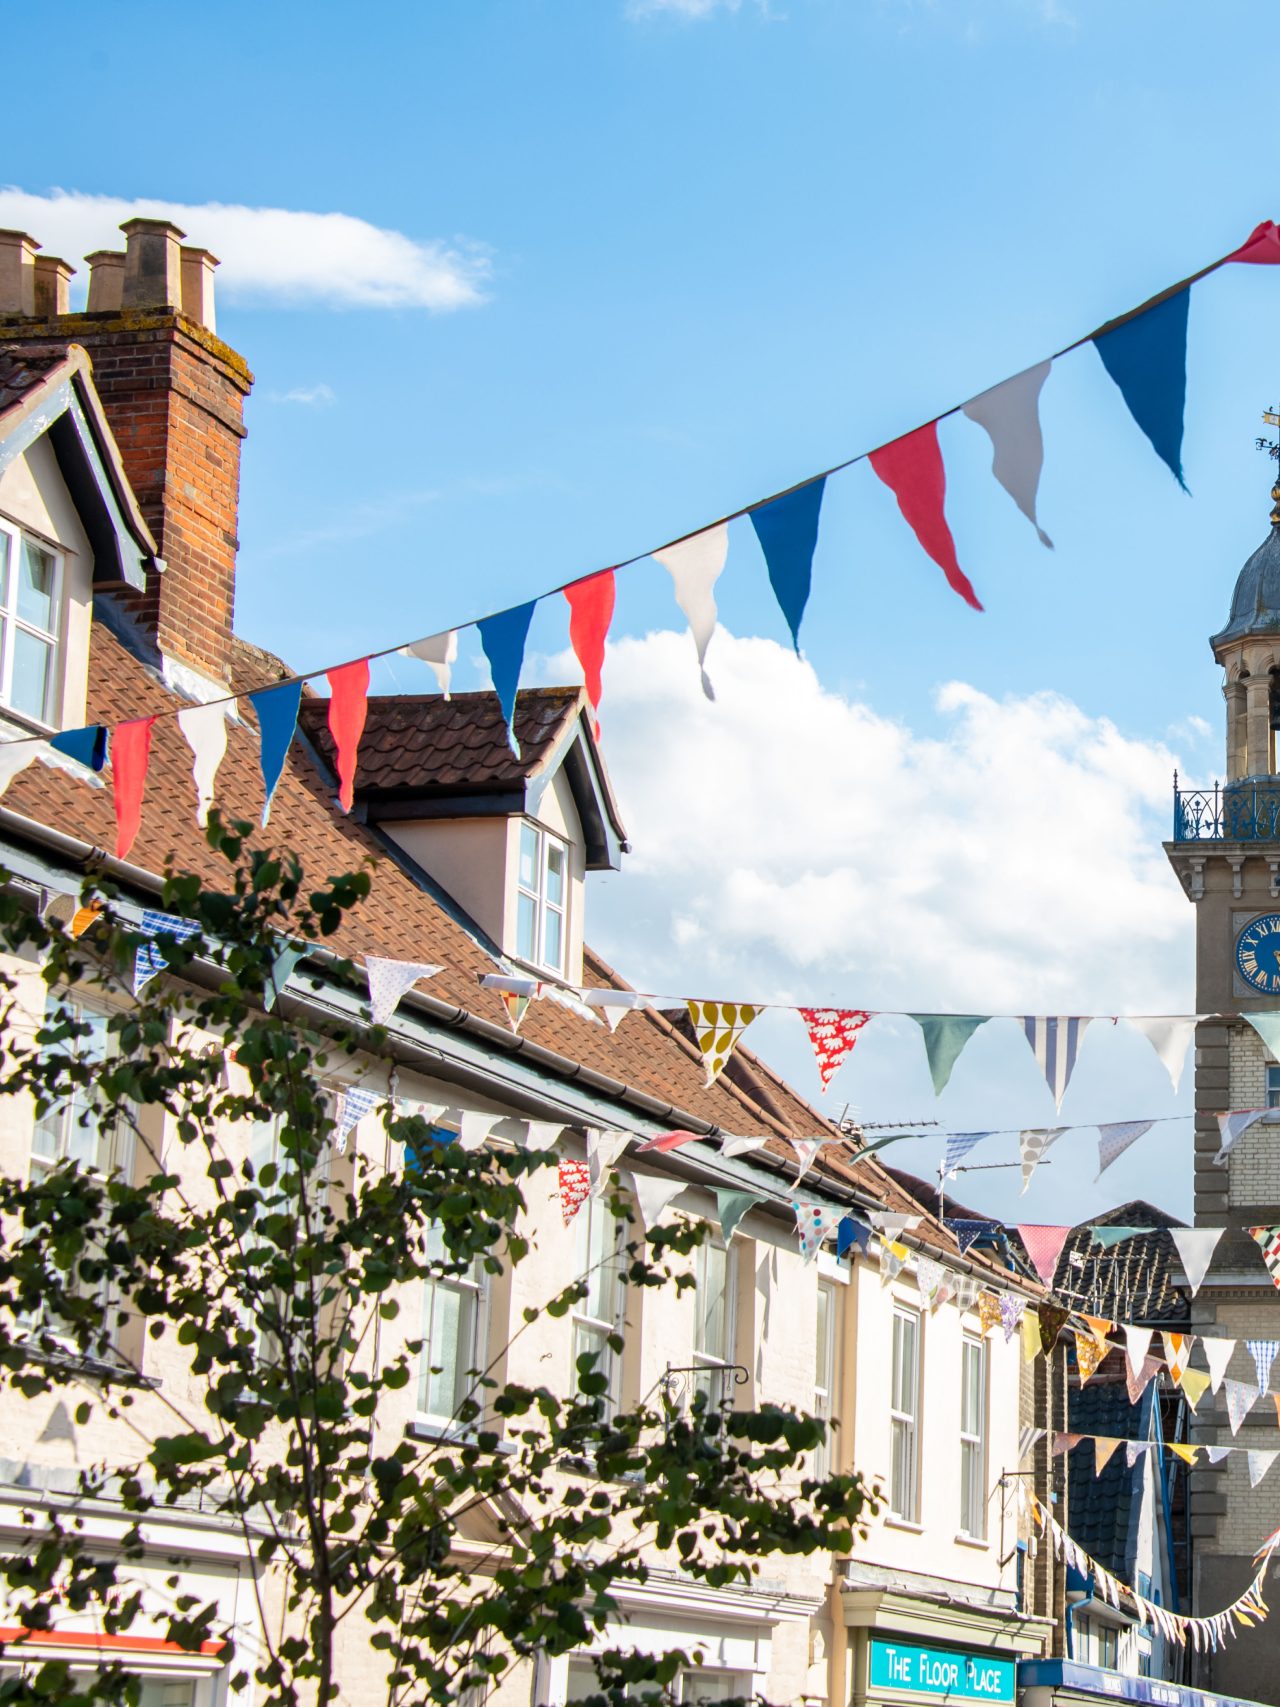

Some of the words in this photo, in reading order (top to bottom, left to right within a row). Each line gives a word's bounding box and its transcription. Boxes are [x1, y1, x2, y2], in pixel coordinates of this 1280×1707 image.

[1255, 923, 1268, 938] XI
[1246, 936, 1258, 947] X
[886, 1648, 911, 1681] THE
[920, 1653, 958, 1687] FLOOR
[966, 1661, 1001, 1693] PLACE
